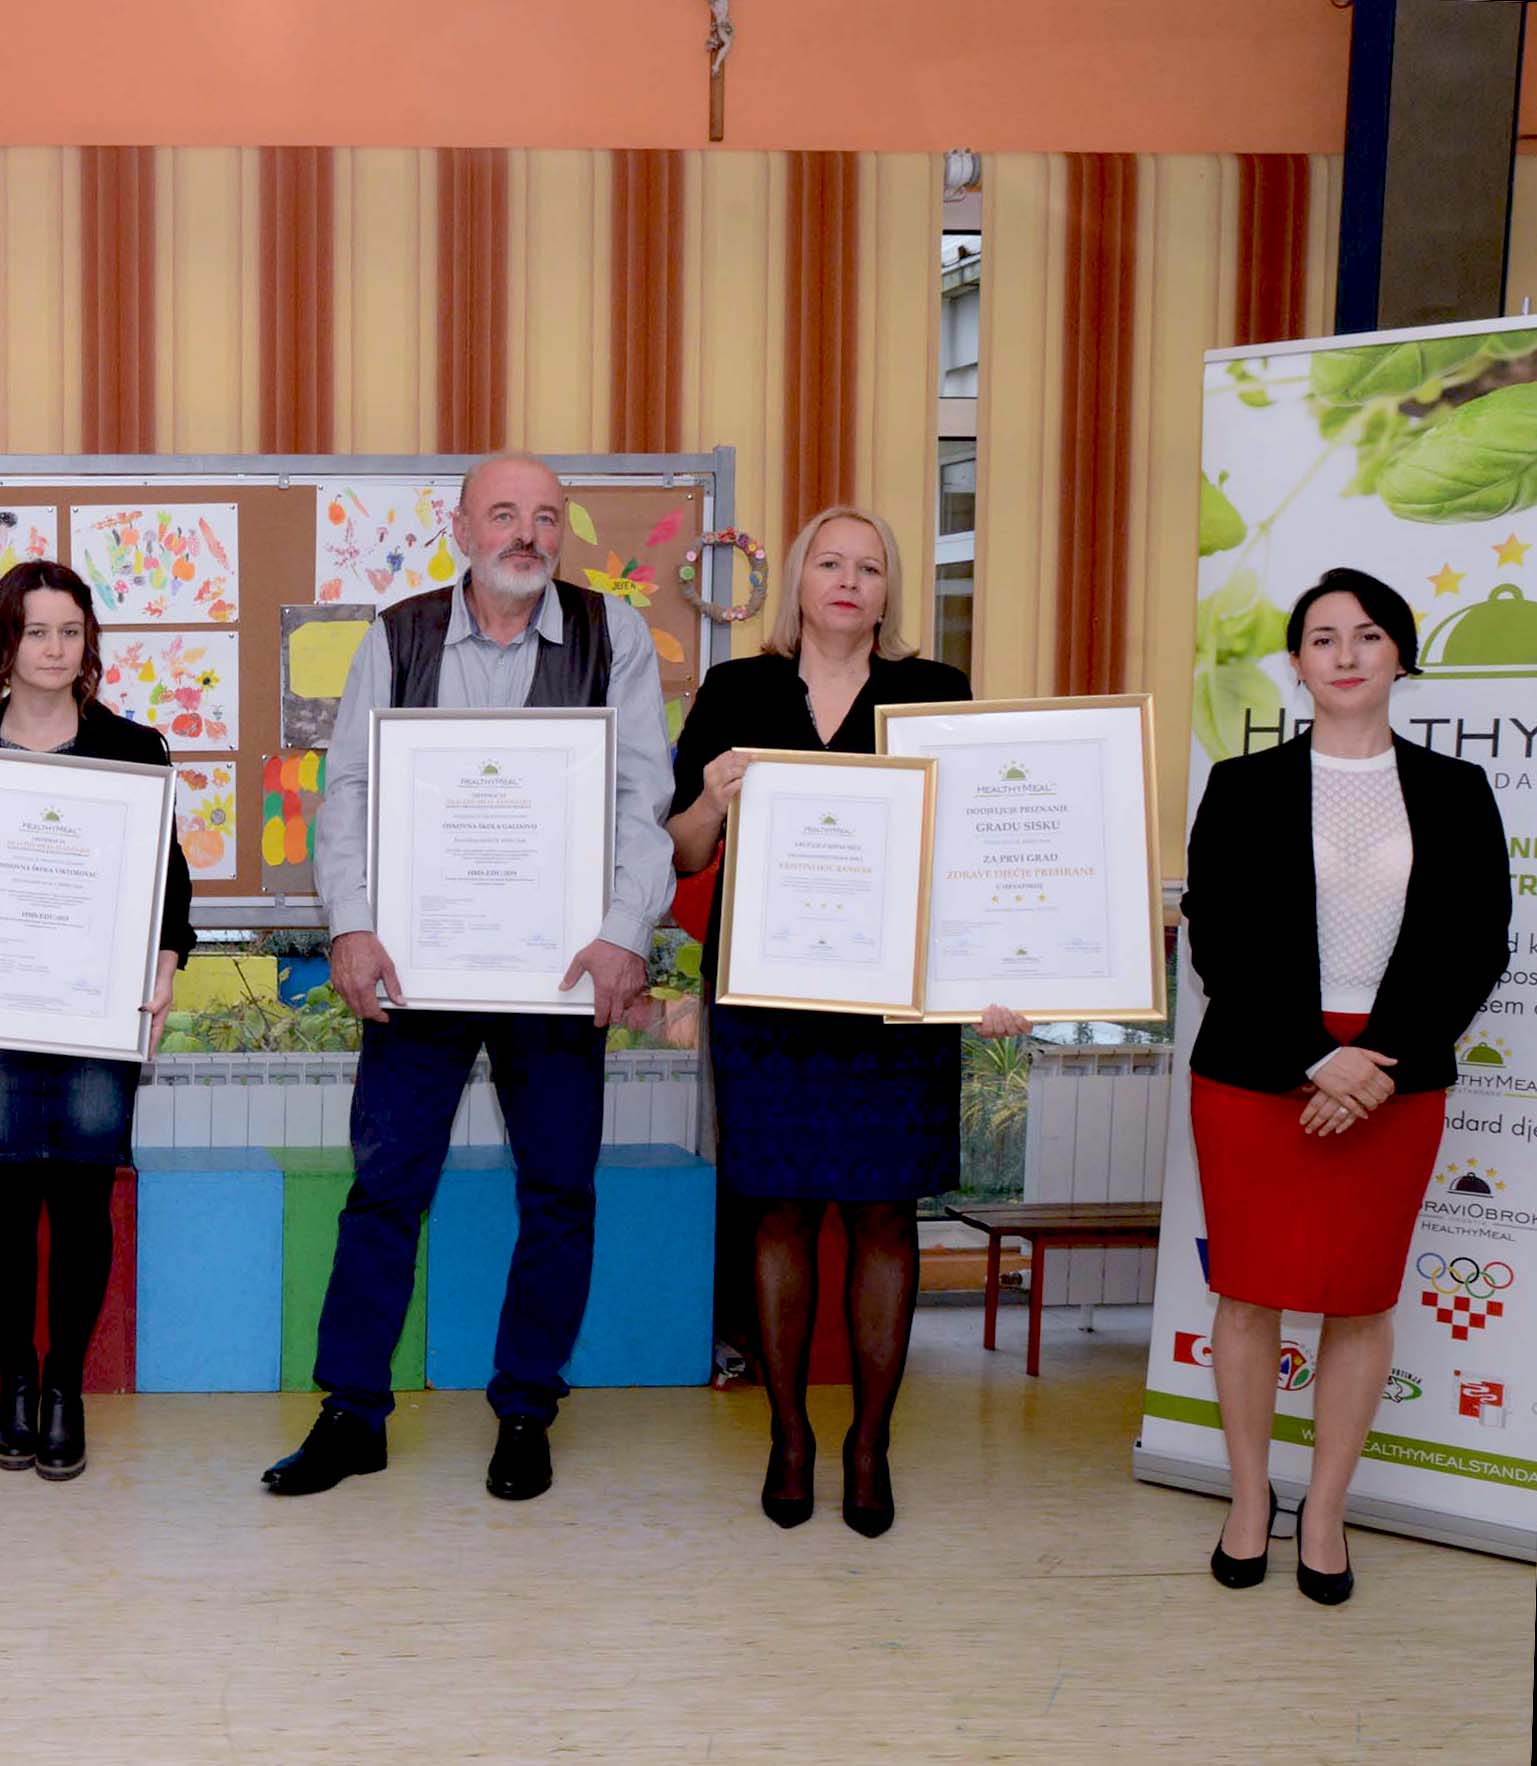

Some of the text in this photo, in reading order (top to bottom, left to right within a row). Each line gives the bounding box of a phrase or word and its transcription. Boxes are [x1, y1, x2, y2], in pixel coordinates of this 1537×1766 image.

[975, 820, 1061, 833] GRADU SISKU
[983, 853, 1059, 864] ZA PRVI GRAD
[945, 869, 992, 880] ZDRAVE
[1034, 866, 1097, 878] PREHRANE
[1421, 1221, 1517, 1242] HEALTHYMEAL
